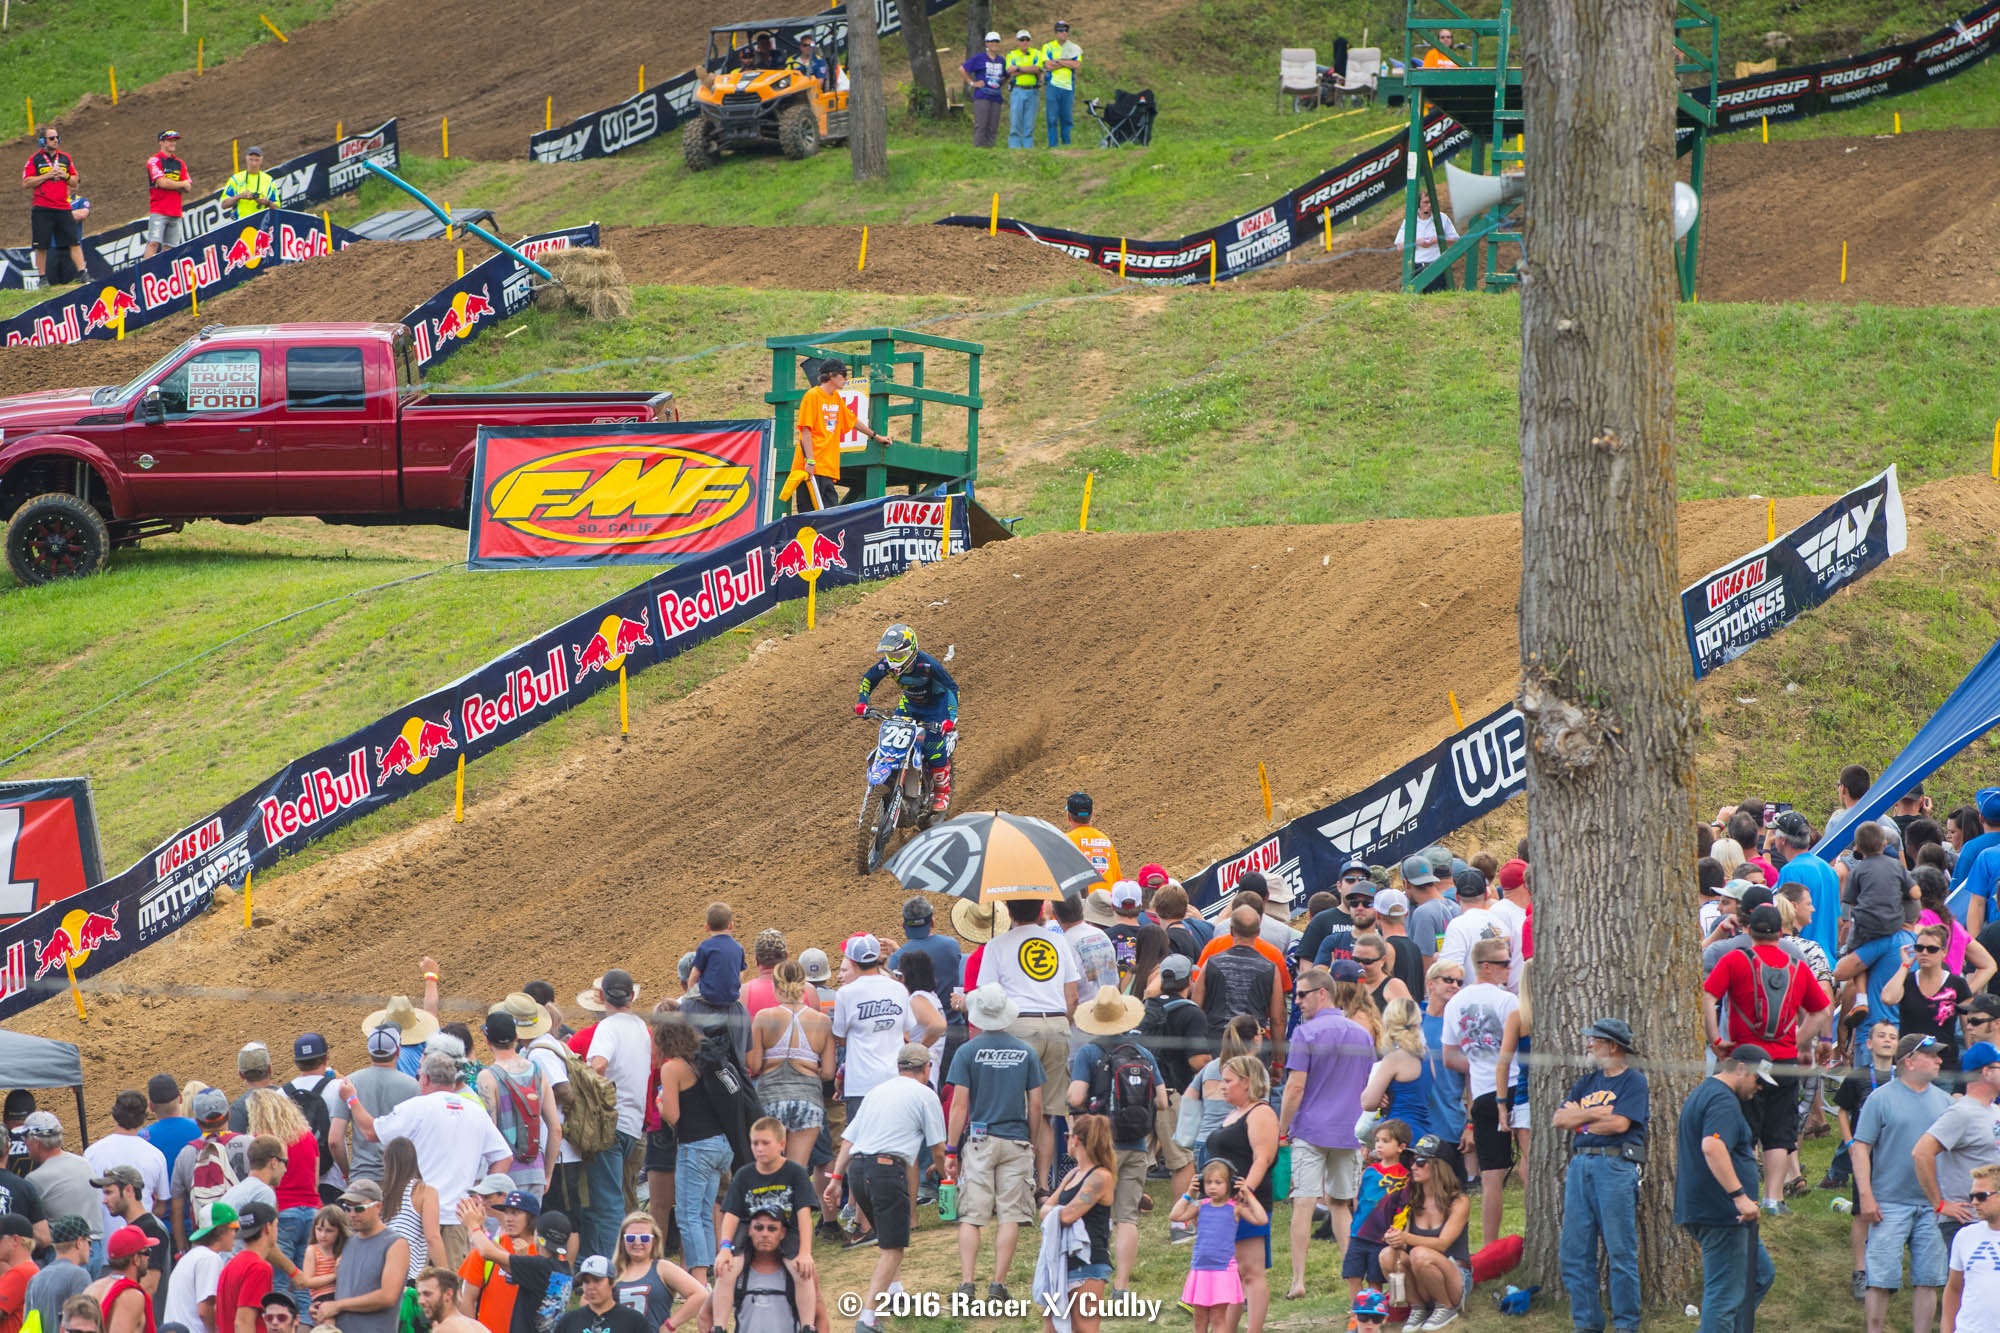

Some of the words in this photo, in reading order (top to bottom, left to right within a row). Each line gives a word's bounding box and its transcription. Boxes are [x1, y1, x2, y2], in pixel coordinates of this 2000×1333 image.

[1820, 56, 1902, 89] PROGRIP
[1716, 79, 1810, 107] PROGRIP
[600, 93, 658, 154] WPS
[1300, 148, 1400, 214] PROGRIP
[1103, 243, 1211, 268] PROGRIP
[1227, 225, 1291, 269] MOTOCROSS
[191, 372, 255, 382] TRUCK
[189, 395, 257, 408] FORD
[488, 457, 754, 522] FMF
[577, 523, 603, 534] SO.
[886, 503, 931, 525] LUCAS
[902, 528, 931, 537] PRO
[1796, 493, 1884, 574] FLY
[1817, 543, 1868, 584] RACING
[1710, 568, 1746, 609] LUCAS
[1746, 559, 1765, 589] OIL
[1726, 594, 1750, 614] PRO
[1695, 586, 1786, 660] MOTOCROSS
[881, 725, 913, 749] 26
[1317, 762, 1438, 854] FLY
[159, 833, 197, 878] LUCAS
[199, 820, 221, 852] OIL
[1261, 839, 1279, 871] OIL
[1350, 818, 1420, 862] RACING
[138, 839, 252, 931] MOTOCROSS
[174, 856, 208, 882] PRO
[857, 999, 904, 1021] Miller
